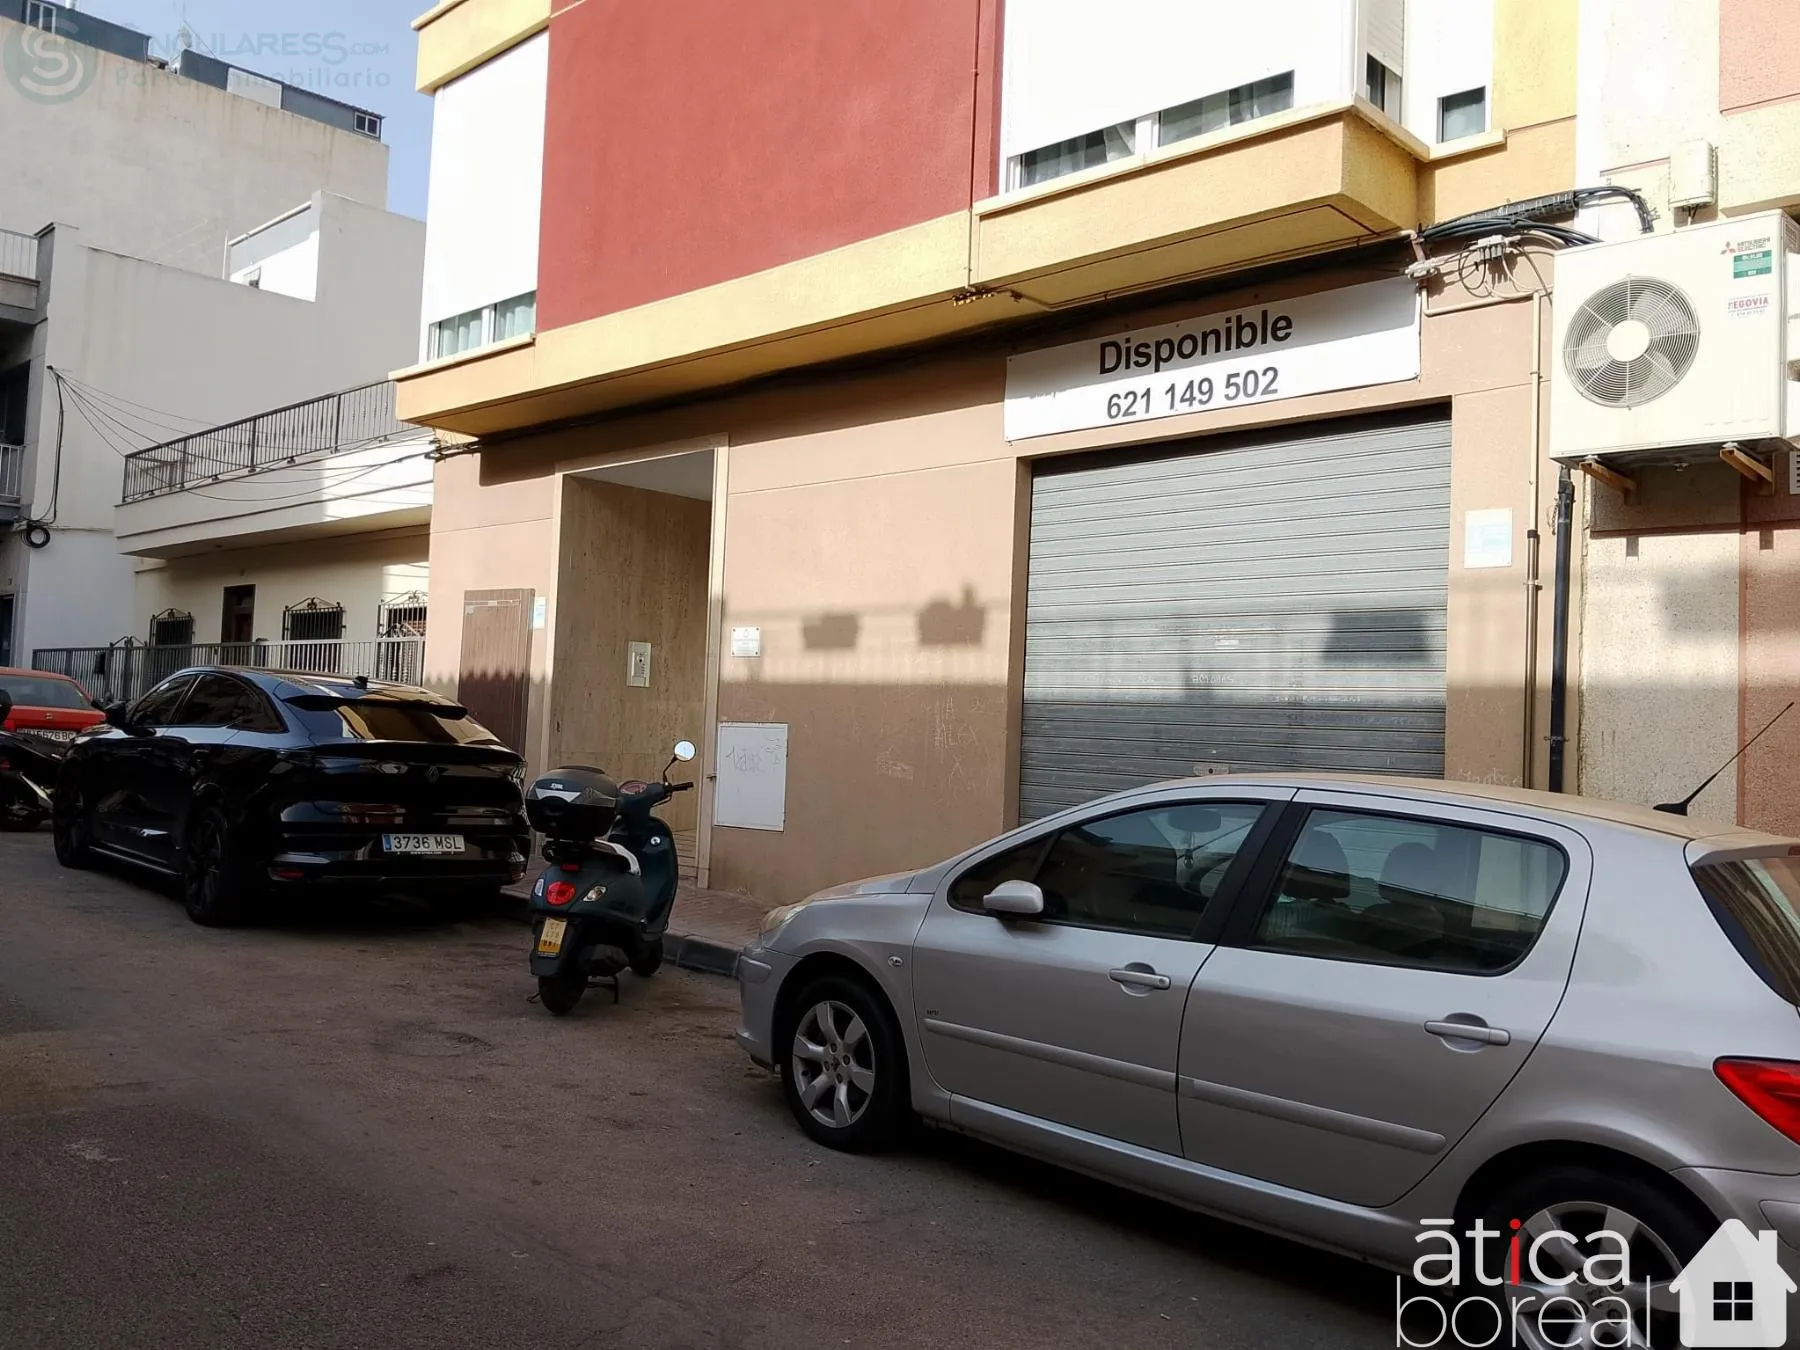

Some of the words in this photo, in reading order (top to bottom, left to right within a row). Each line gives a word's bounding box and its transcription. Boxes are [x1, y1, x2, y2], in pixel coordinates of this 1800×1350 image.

[1099, 310, 1293, 375] Disponible
[1107, 387, 1151, 420] 621
[1165, 377, 1214, 411] 149
[1224, 366, 1279, 402] 502
[393, 836, 431, 850] 3736
[434, 836, 463, 850] MSL
